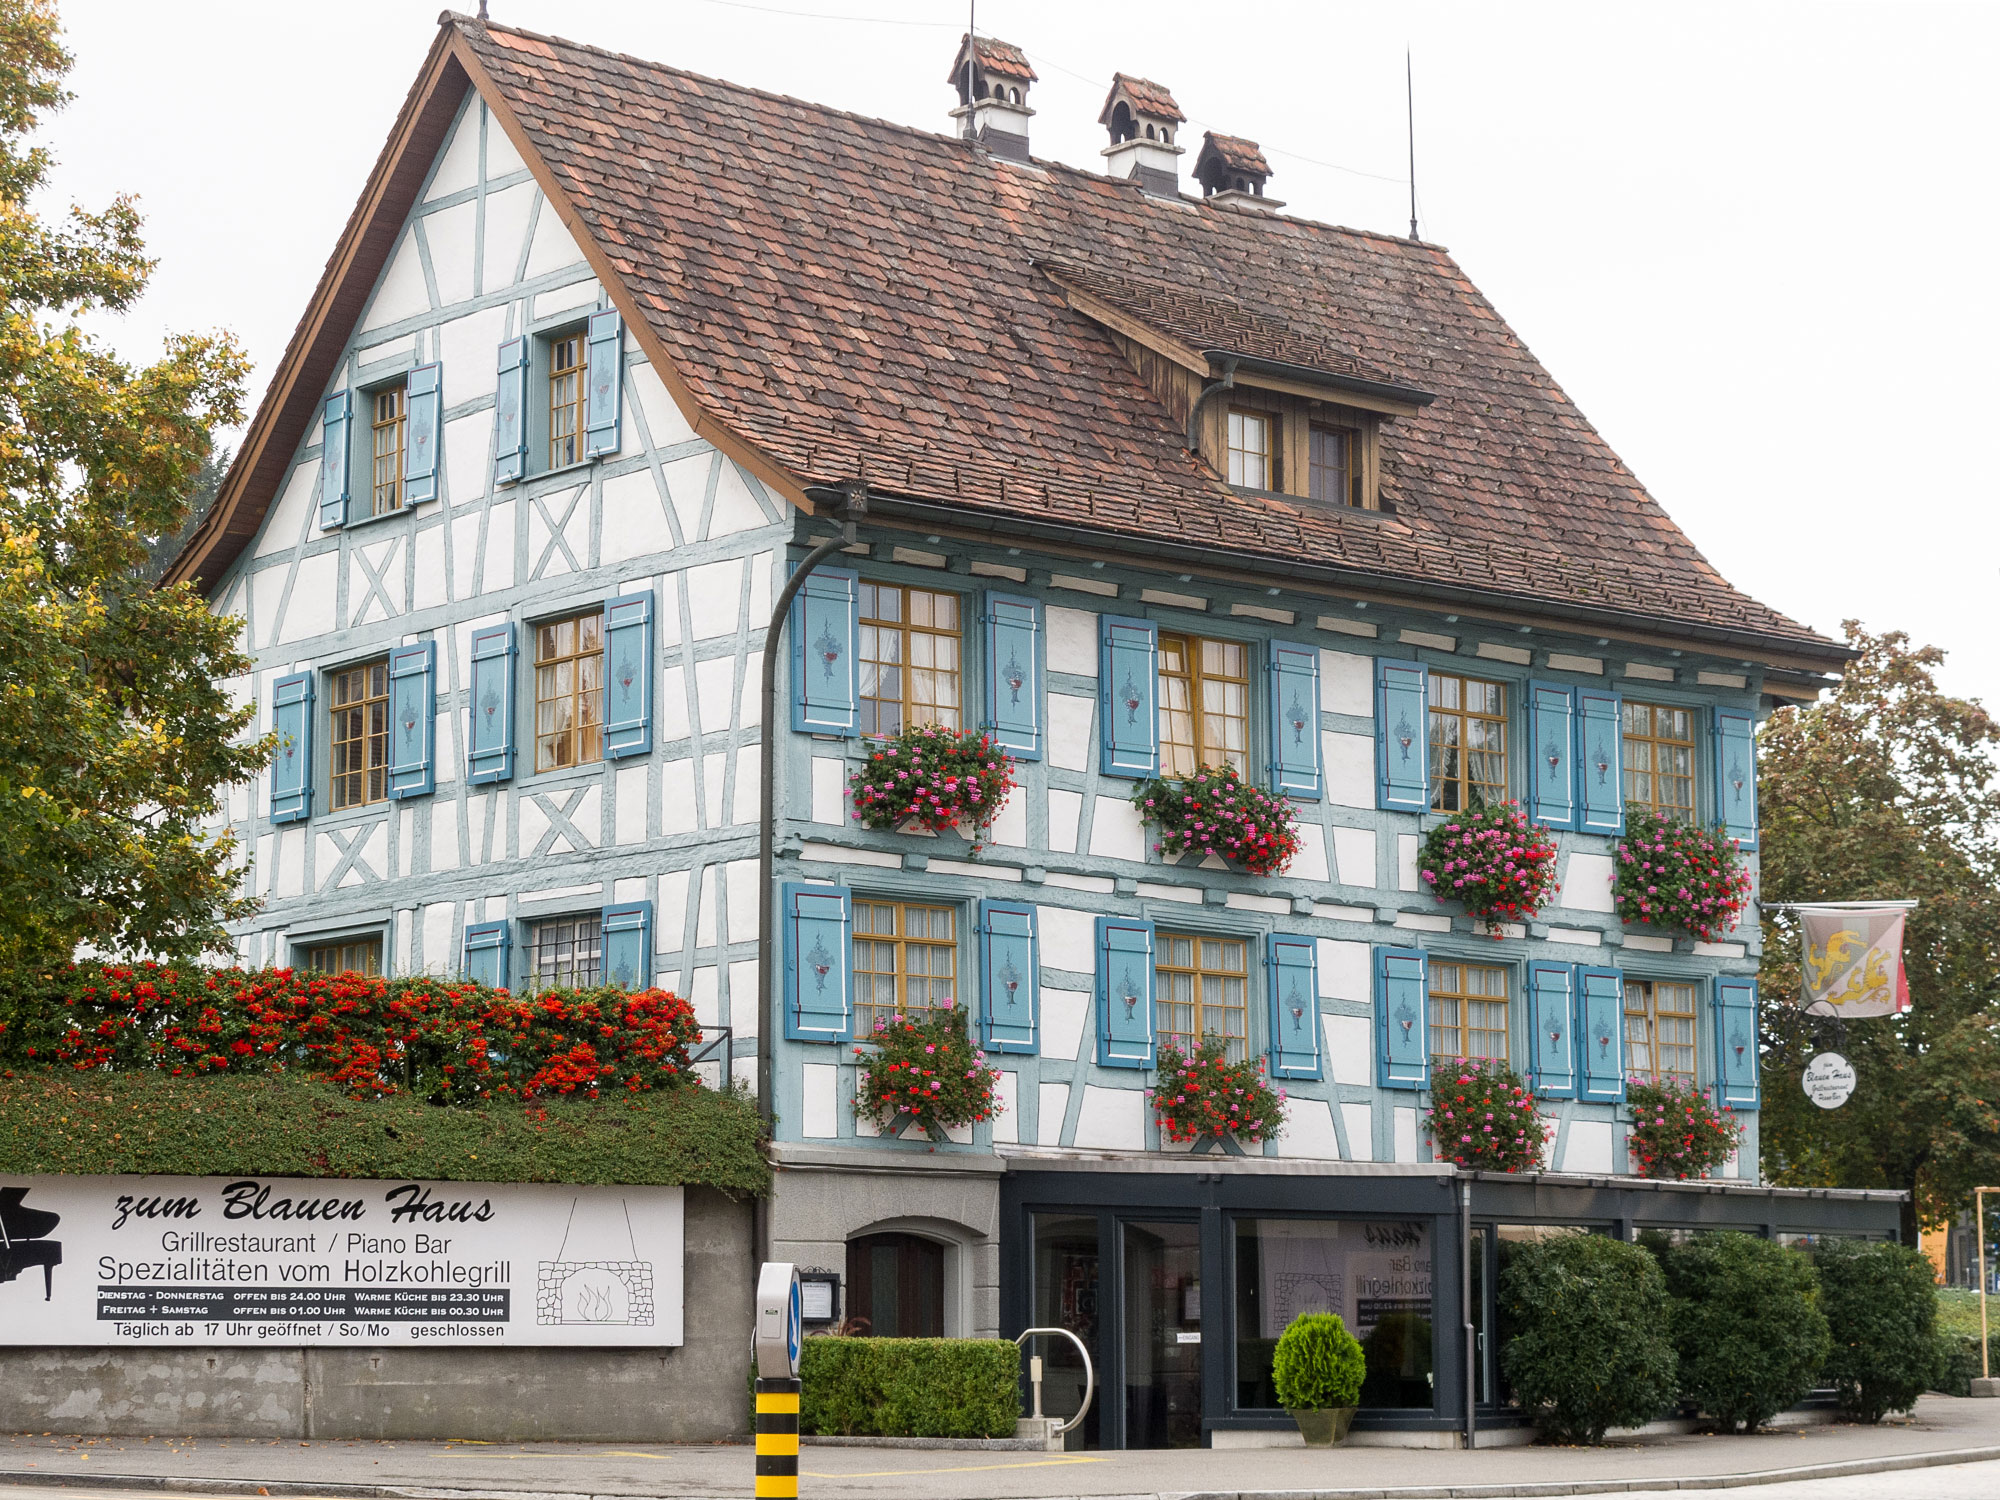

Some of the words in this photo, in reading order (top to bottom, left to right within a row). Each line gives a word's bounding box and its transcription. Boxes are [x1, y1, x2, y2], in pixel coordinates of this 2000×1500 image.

[112, 1194, 202, 1230] zum
[221, 1180, 366, 1221] Blauen
[385, 1183, 495, 1223] Haus
[161, 1230, 316, 1253] Grillrestaurant
[328, 1232, 338, 1253] /
[347, 1232, 406, 1254] Piano
[415, 1233, 452, 1254] Bar
[98, 1255, 268, 1285] Spezialitäten
[278, 1264, 330, 1282] vom
[345, 1259, 510, 1288] Holzkohlegrill
[97, 1290, 146, 1300] DIENSTAG
[155, 1291, 225, 1301] DONNERSTAG
[233, 1292, 268, 1301] OFFEN
[270, 1293, 288, 1301] BIS
[289, 1292, 322, 1301] 24.00
[323, 1292, 346, 1301] UHR
[354, 1292, 392, 1302] WARME
[394, 1291, 428, 1302] KÜCHE
[430, 1294, 447, 1302] BIS
[449, 1293, 480, 1302] 23.30
[482, 1293, 504, 1302] UHR
[102, 1305, 146, 1314] FREITAG
[149, 1304, 158, 1314] +
[161, 1305, 209, 1315] SAMSTAG
[232, 1307, 267, 1315] OFFEN
[270, 1307, 287, 1315] BIS
[289, 1306, 321, 1315] 01.00
[323, 1306, 346, 1315] UHR
[354, 1306, 392, 1316] WARME
[394, 1305, 428, 1316] KÜCHE
[430, 1308, 447, 1316] BIS
[448, 1307, 480, 1316] 00.30
[482, 1307, 504, 1316] UHR
[113, 1322, 169, 1339] Täglich
[174, 1322, 194, 1336] ab
[204, 1322, 220, 1336] 17
[226, 1322, 253, 1336] Uhr
[257, 1322, 322, 1339] geöffnet
[327, 1323, 335, 1337] /
[339, 1322, 390, 1337] So/Mo
[410, 1323, 504, 1338] geschlossen
